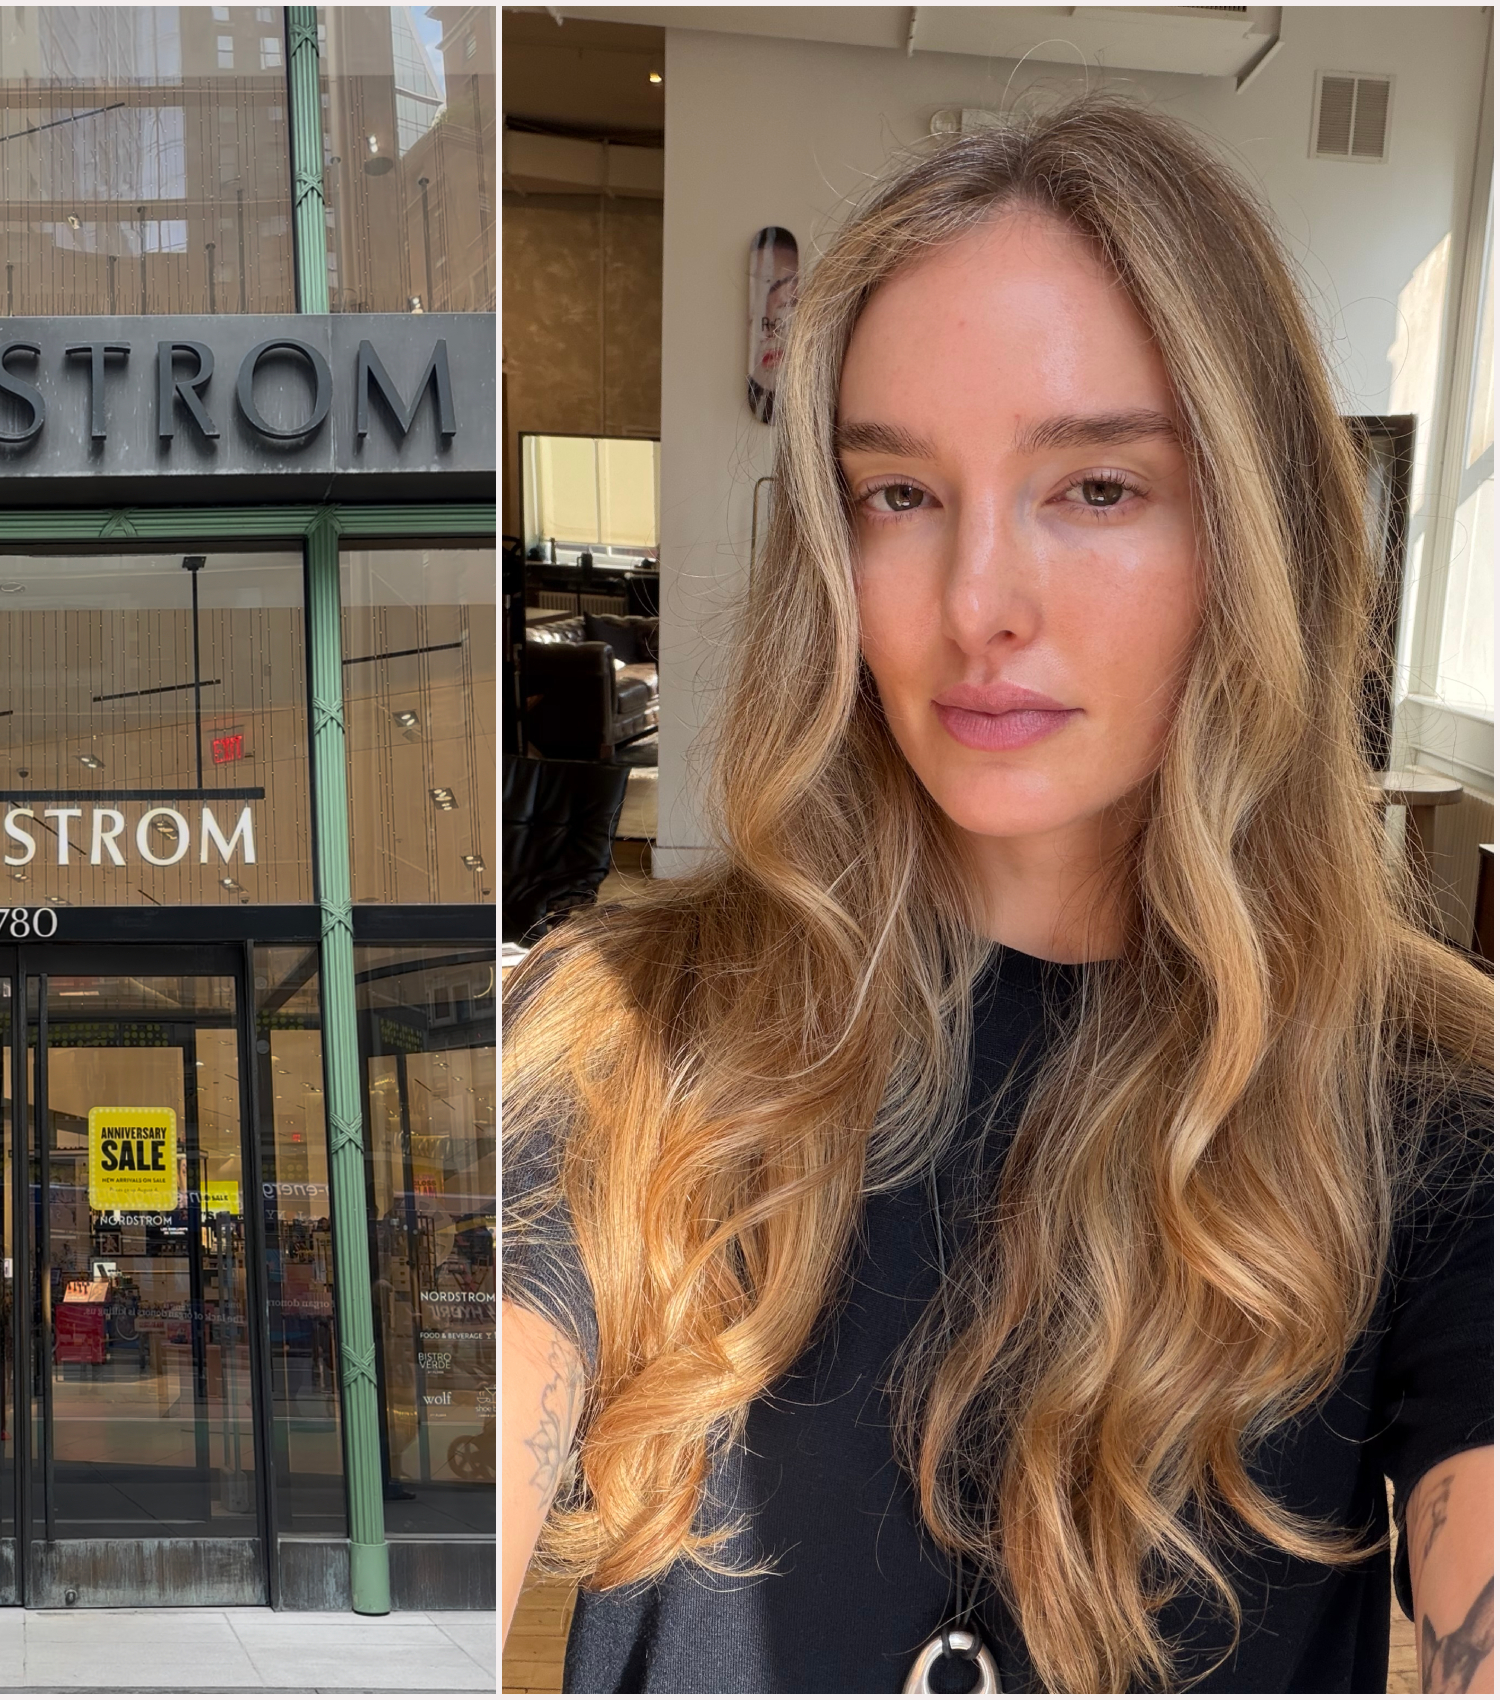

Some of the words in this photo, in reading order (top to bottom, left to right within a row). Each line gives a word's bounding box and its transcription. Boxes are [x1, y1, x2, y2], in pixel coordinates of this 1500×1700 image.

[213, 736, 242, 763] EXIT
[101, 1127, 167, 1139] ANNIVERSARY
[101, 1140, 166, 1172] SALE
[100, 1215, 172, 1226] NORDSTROM
[420, 1291, 496, 1302] NORDSTROM
[447, 1332, 482, 1340] BEVERAGE
[418, 1352, 452, 1361] BISTRO
[419, 1360, 452, 1369] VERDE
[422, 1391, 452, 1405] wolf
[475, 1404, 492, 1412] shoe
